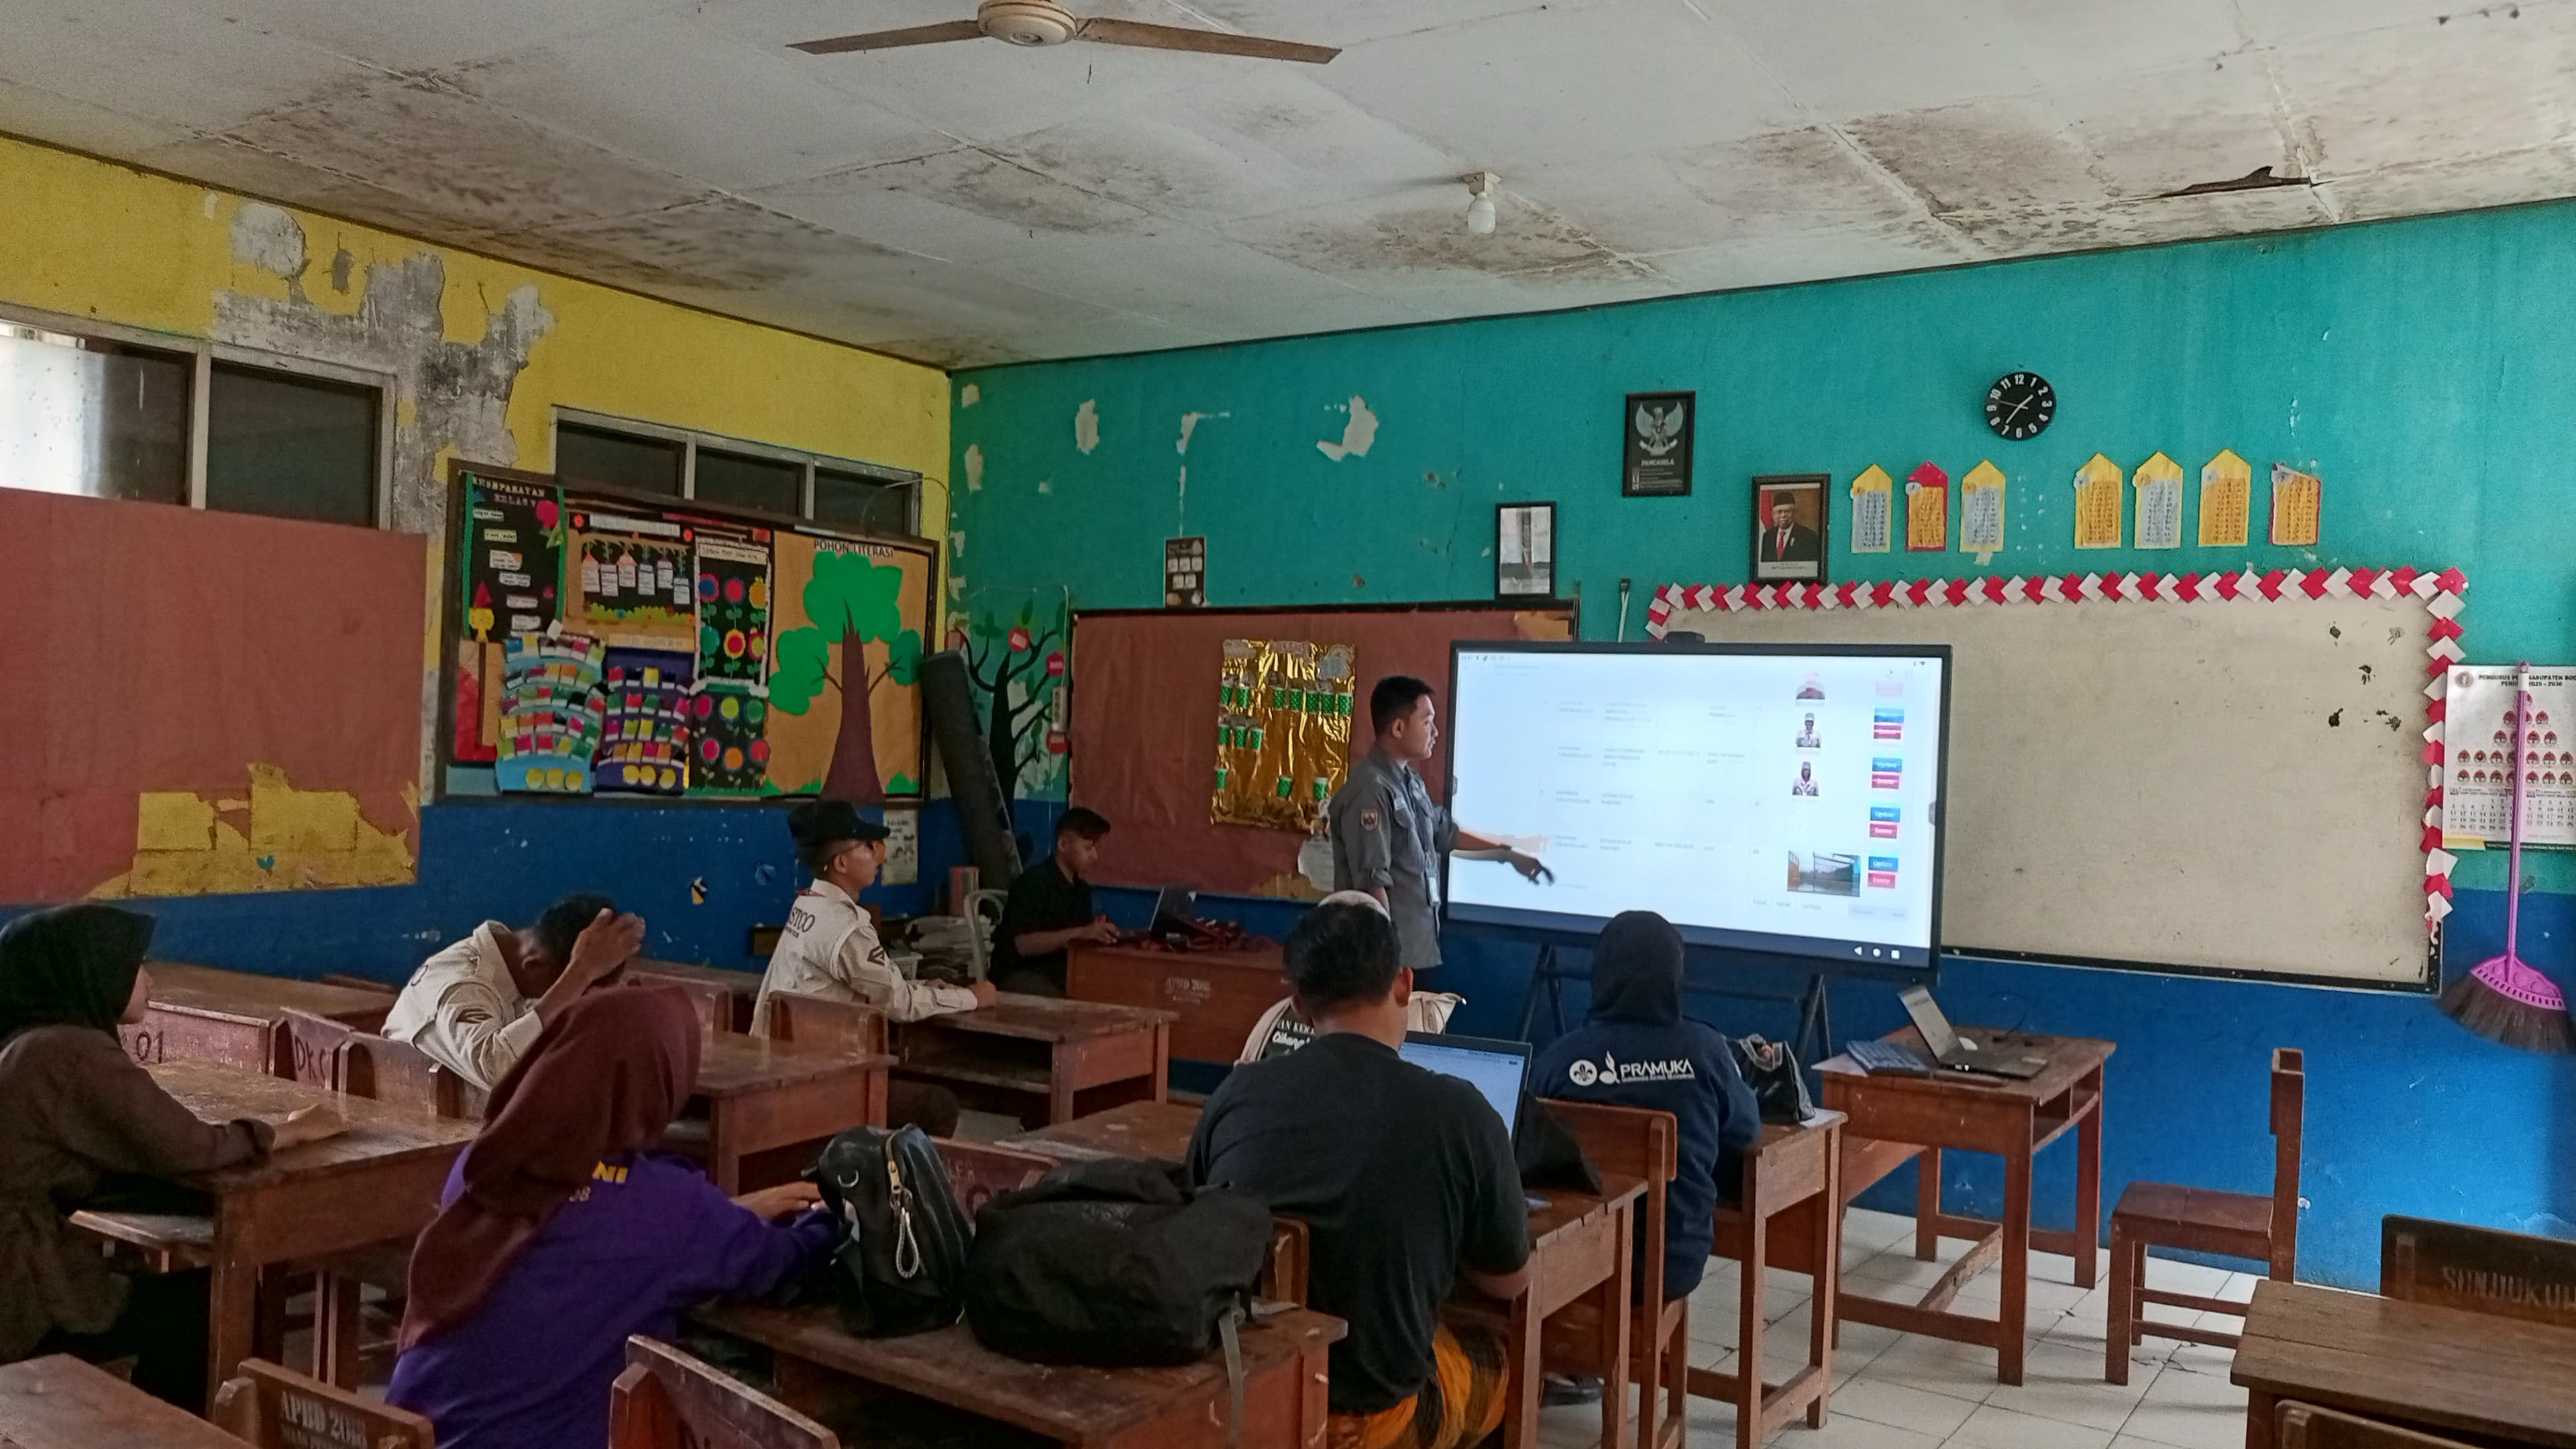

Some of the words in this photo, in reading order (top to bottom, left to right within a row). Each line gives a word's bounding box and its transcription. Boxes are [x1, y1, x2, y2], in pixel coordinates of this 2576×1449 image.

[2000, 378, 2011, 389] 11
[2015, 374, 2025, 385] 12
[2030, 377, 2037, 387] 1
[1990, 389, 2002, 400] 10
[2038, 386, 2048, 396] 2
[1990, 417, 2000, 426] 8
[2039, 413, 2049, 421] 4
[2002, 425, 2010, 435] 7
[2016, 427, 2022, 438] 6
[2029, 423, 2037, 433] 5
[814, 538, 849, 553] POHON
[853, 544, 894, 558] LITERASI
[1873, 860, 1893, 868] Update
[1619, 1059, 1695, 1077] PRAMUKA
